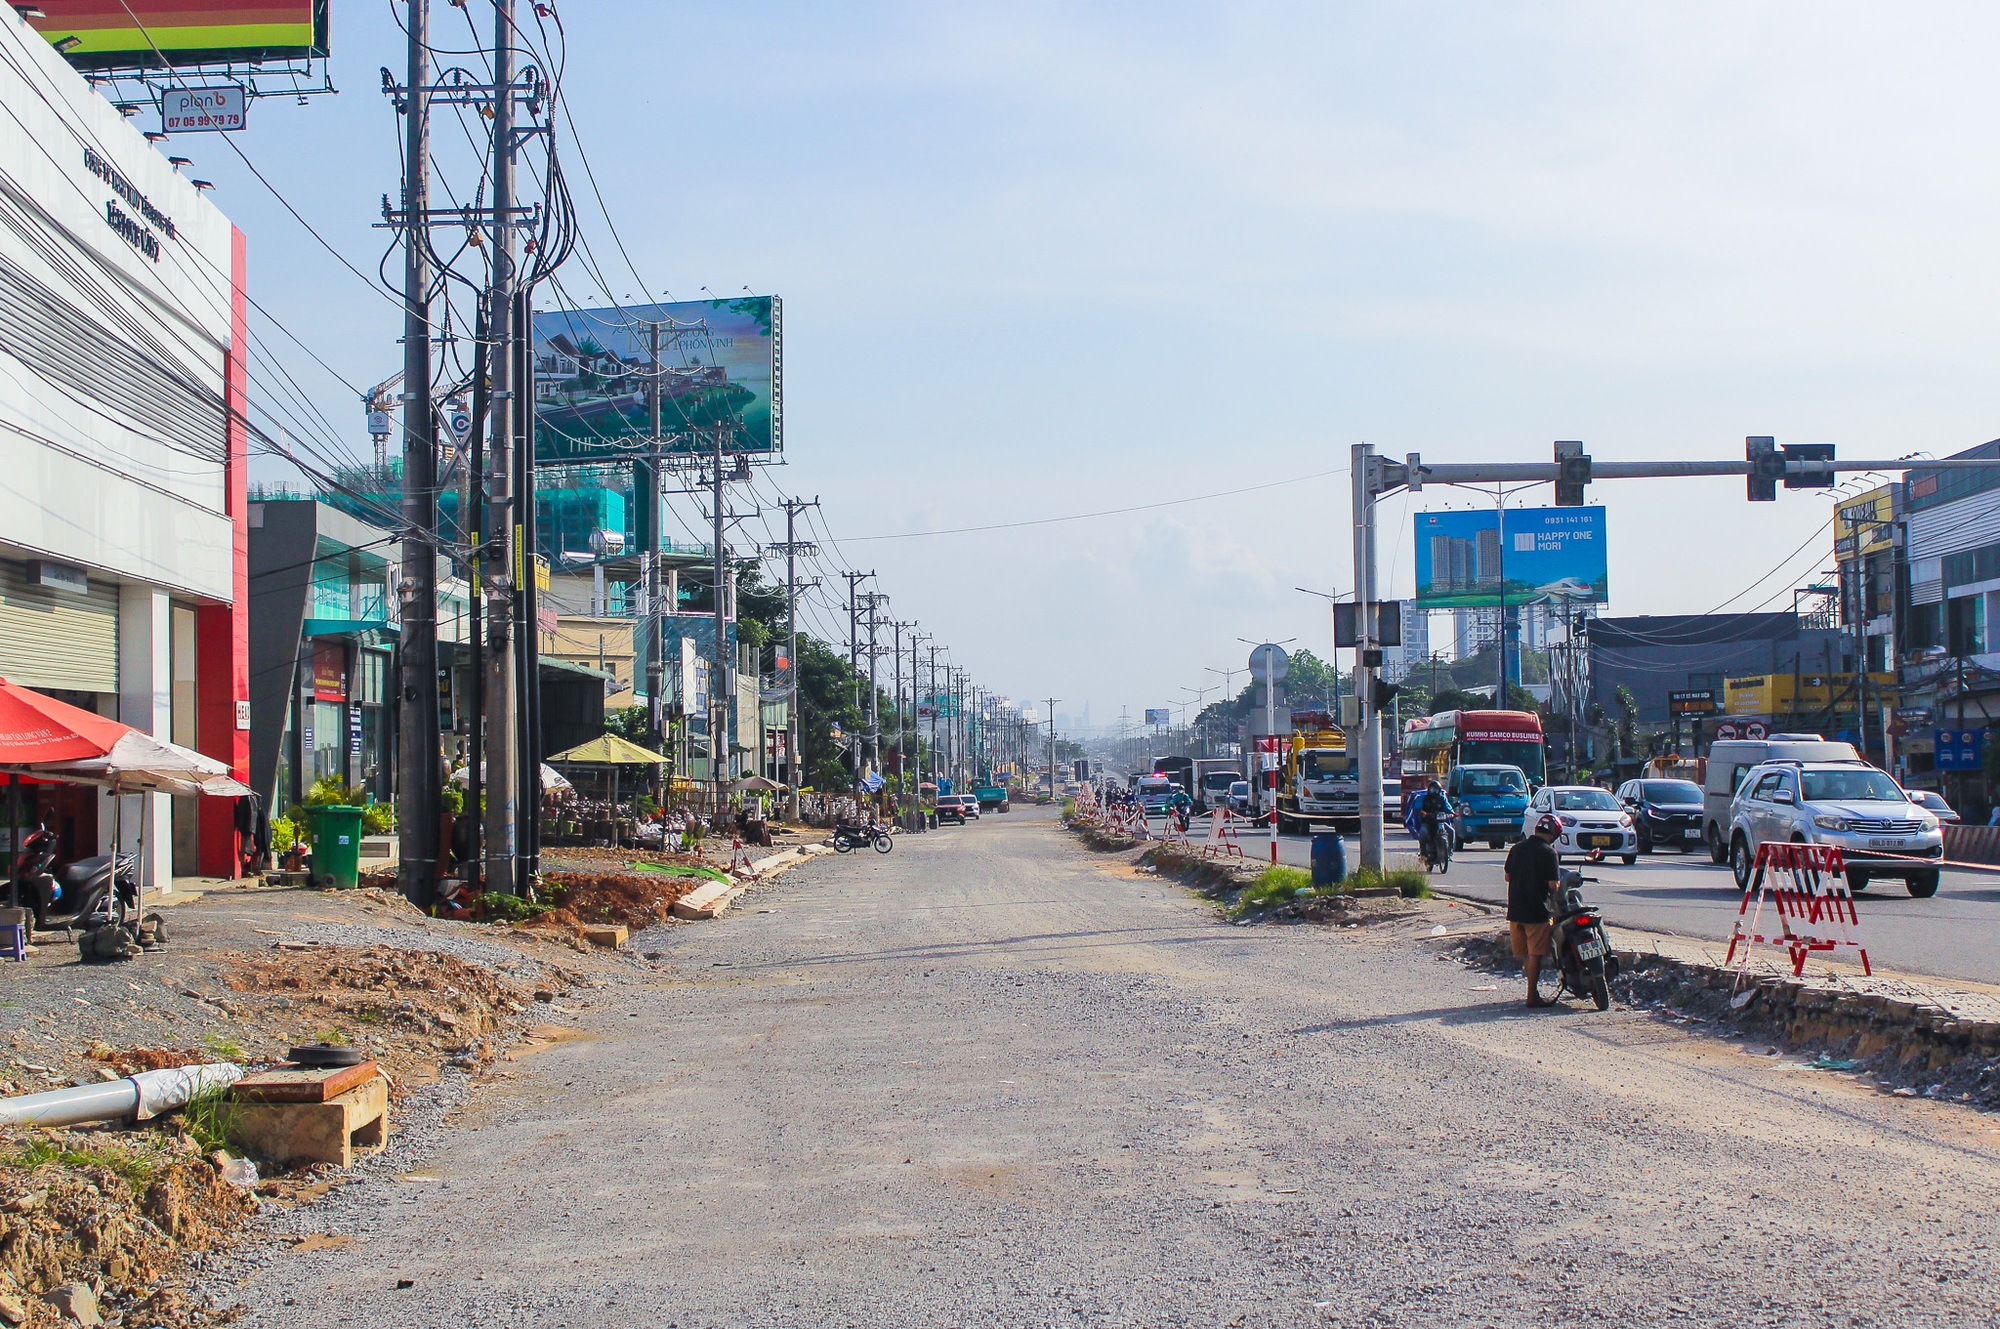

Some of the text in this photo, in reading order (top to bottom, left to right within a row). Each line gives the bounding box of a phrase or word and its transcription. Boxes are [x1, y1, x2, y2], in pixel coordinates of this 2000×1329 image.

[168, 113, 240, 128] 07 05 99 79 79
[1537, 530, 1593, 541] HAPPY ONE
[1538, 541, 1562, 551] MORI
[1512, 732, 1539, 740] BUSLINES
